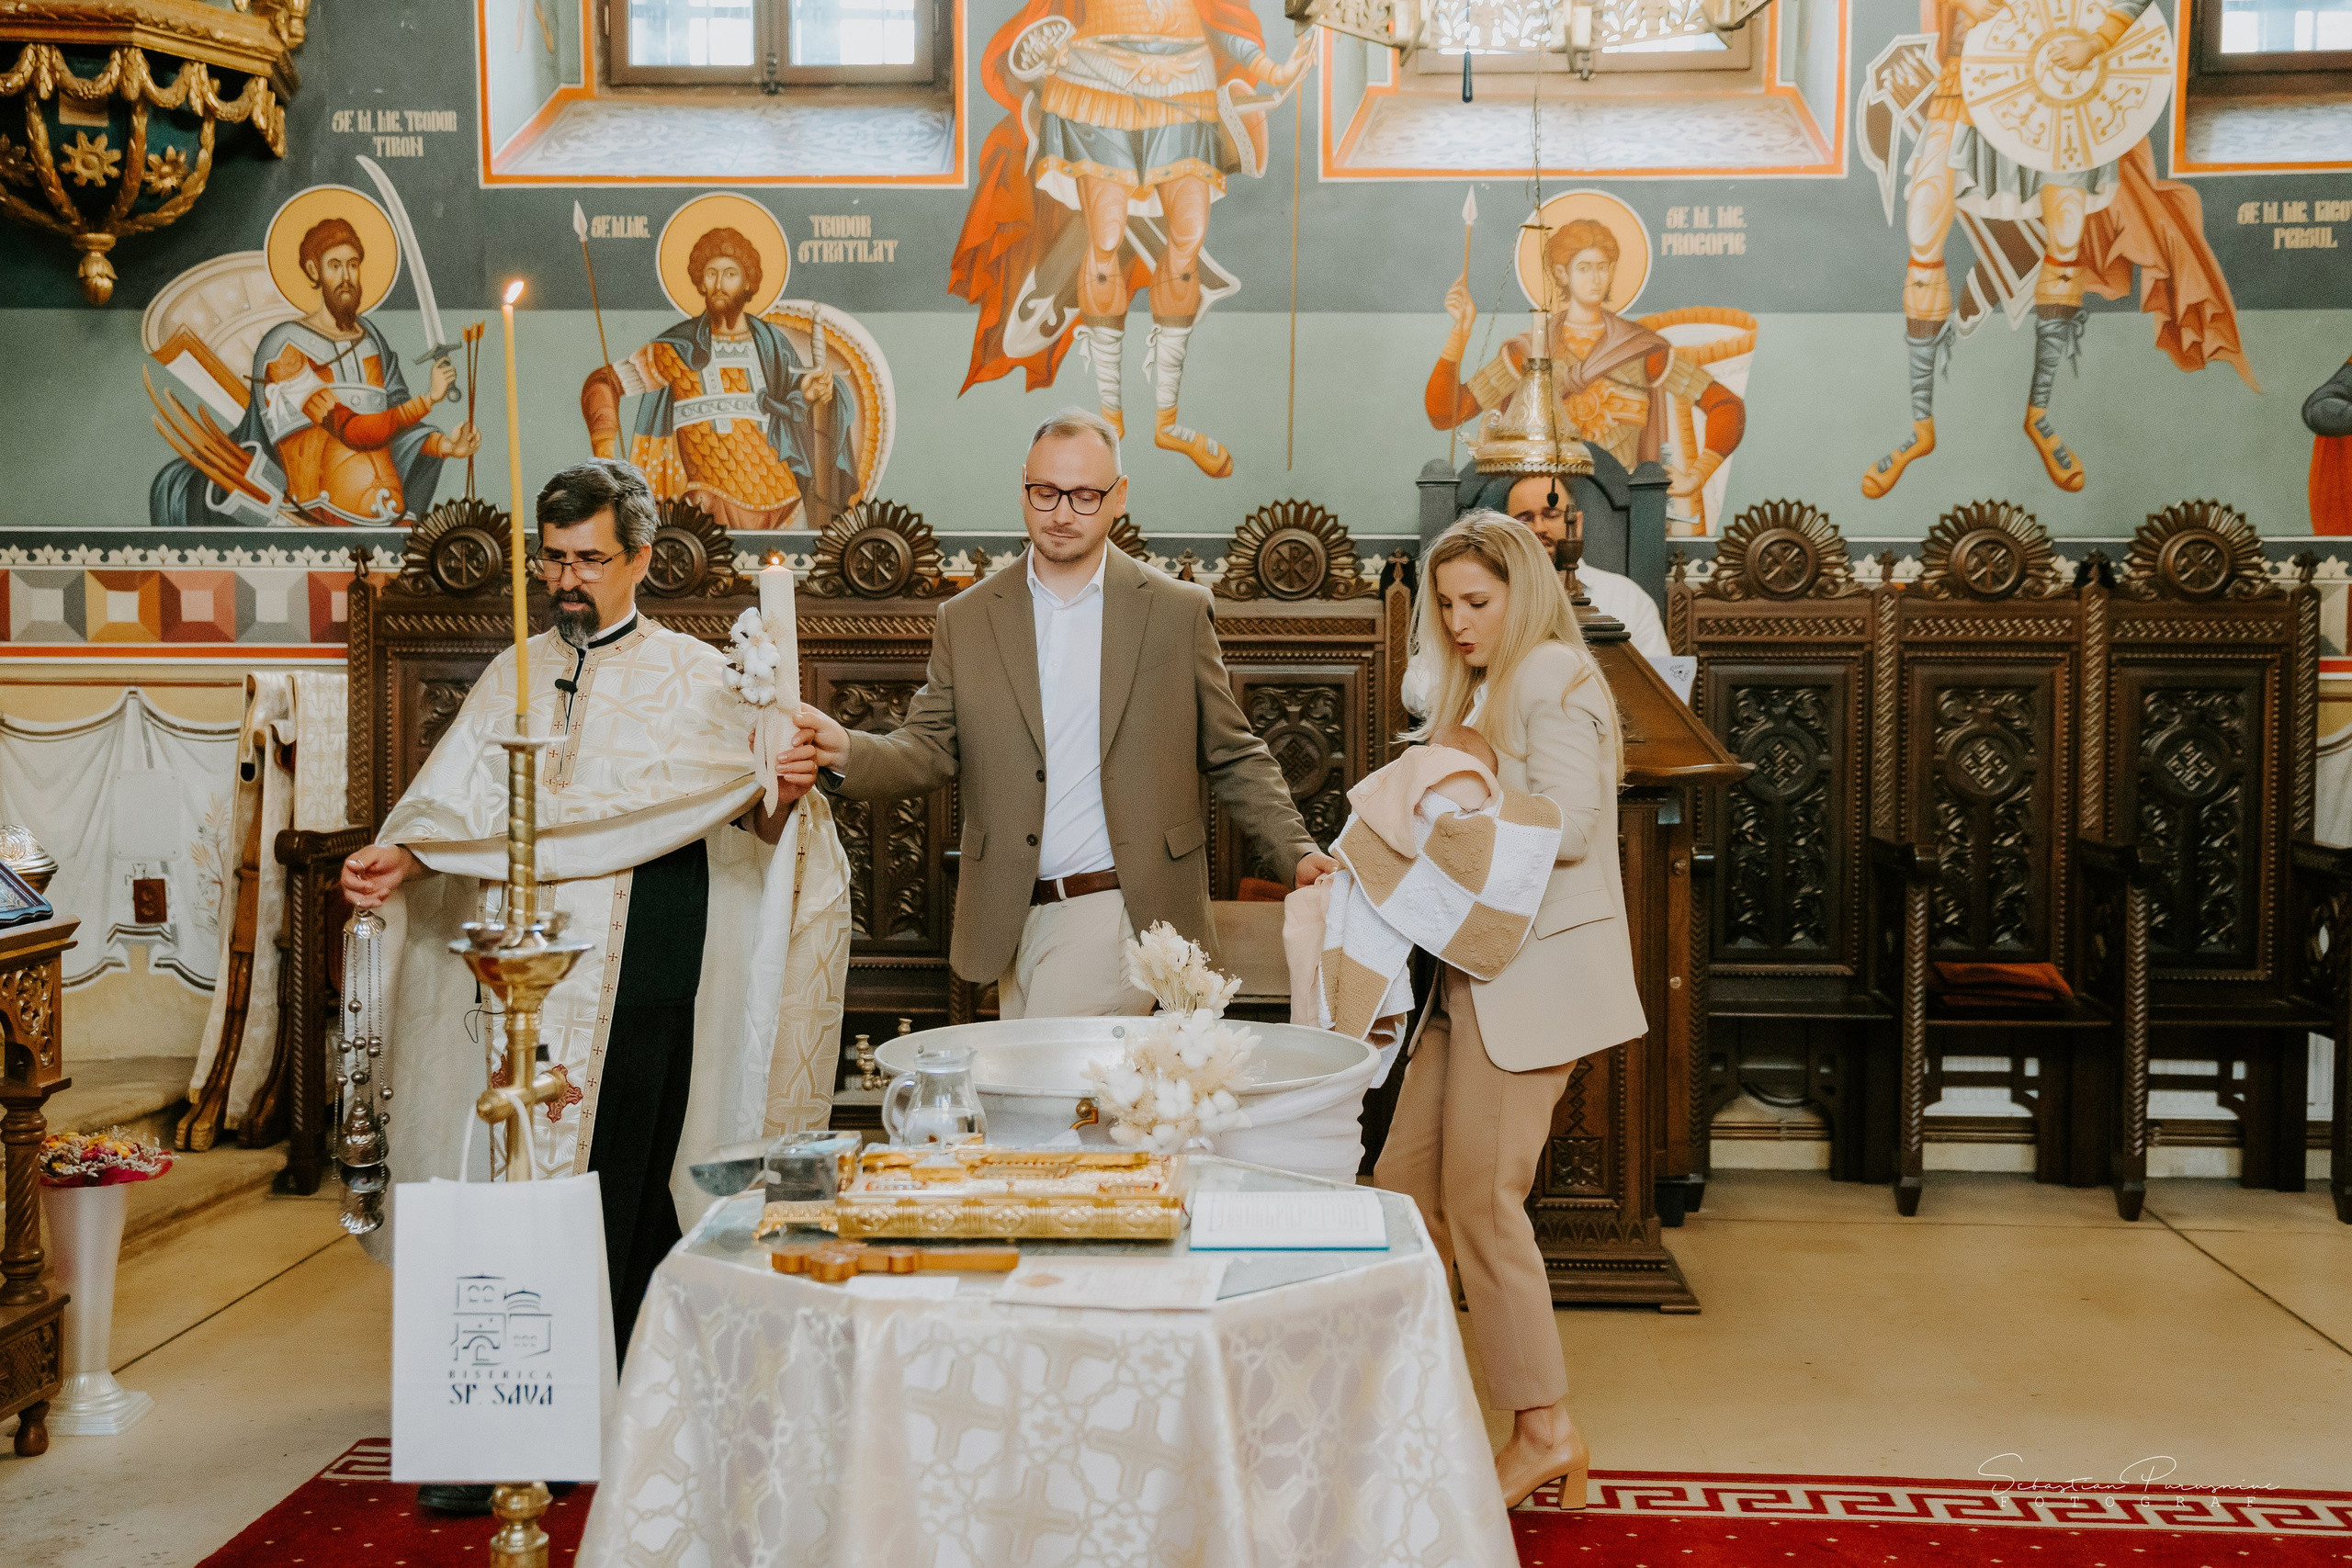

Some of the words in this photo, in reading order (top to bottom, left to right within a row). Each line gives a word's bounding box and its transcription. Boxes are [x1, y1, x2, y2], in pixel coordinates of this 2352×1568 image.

[403, 110, 457, 131] TEODOR
[373, 136, 424, 157] TIRON
[809, 215, 871, 238] TEODOR
[797, 240, 899, 263] STRATILAT
[1661, 232, 1747, 255] PROCOPIE
[492, 1383, 552, 1404] SAVA
